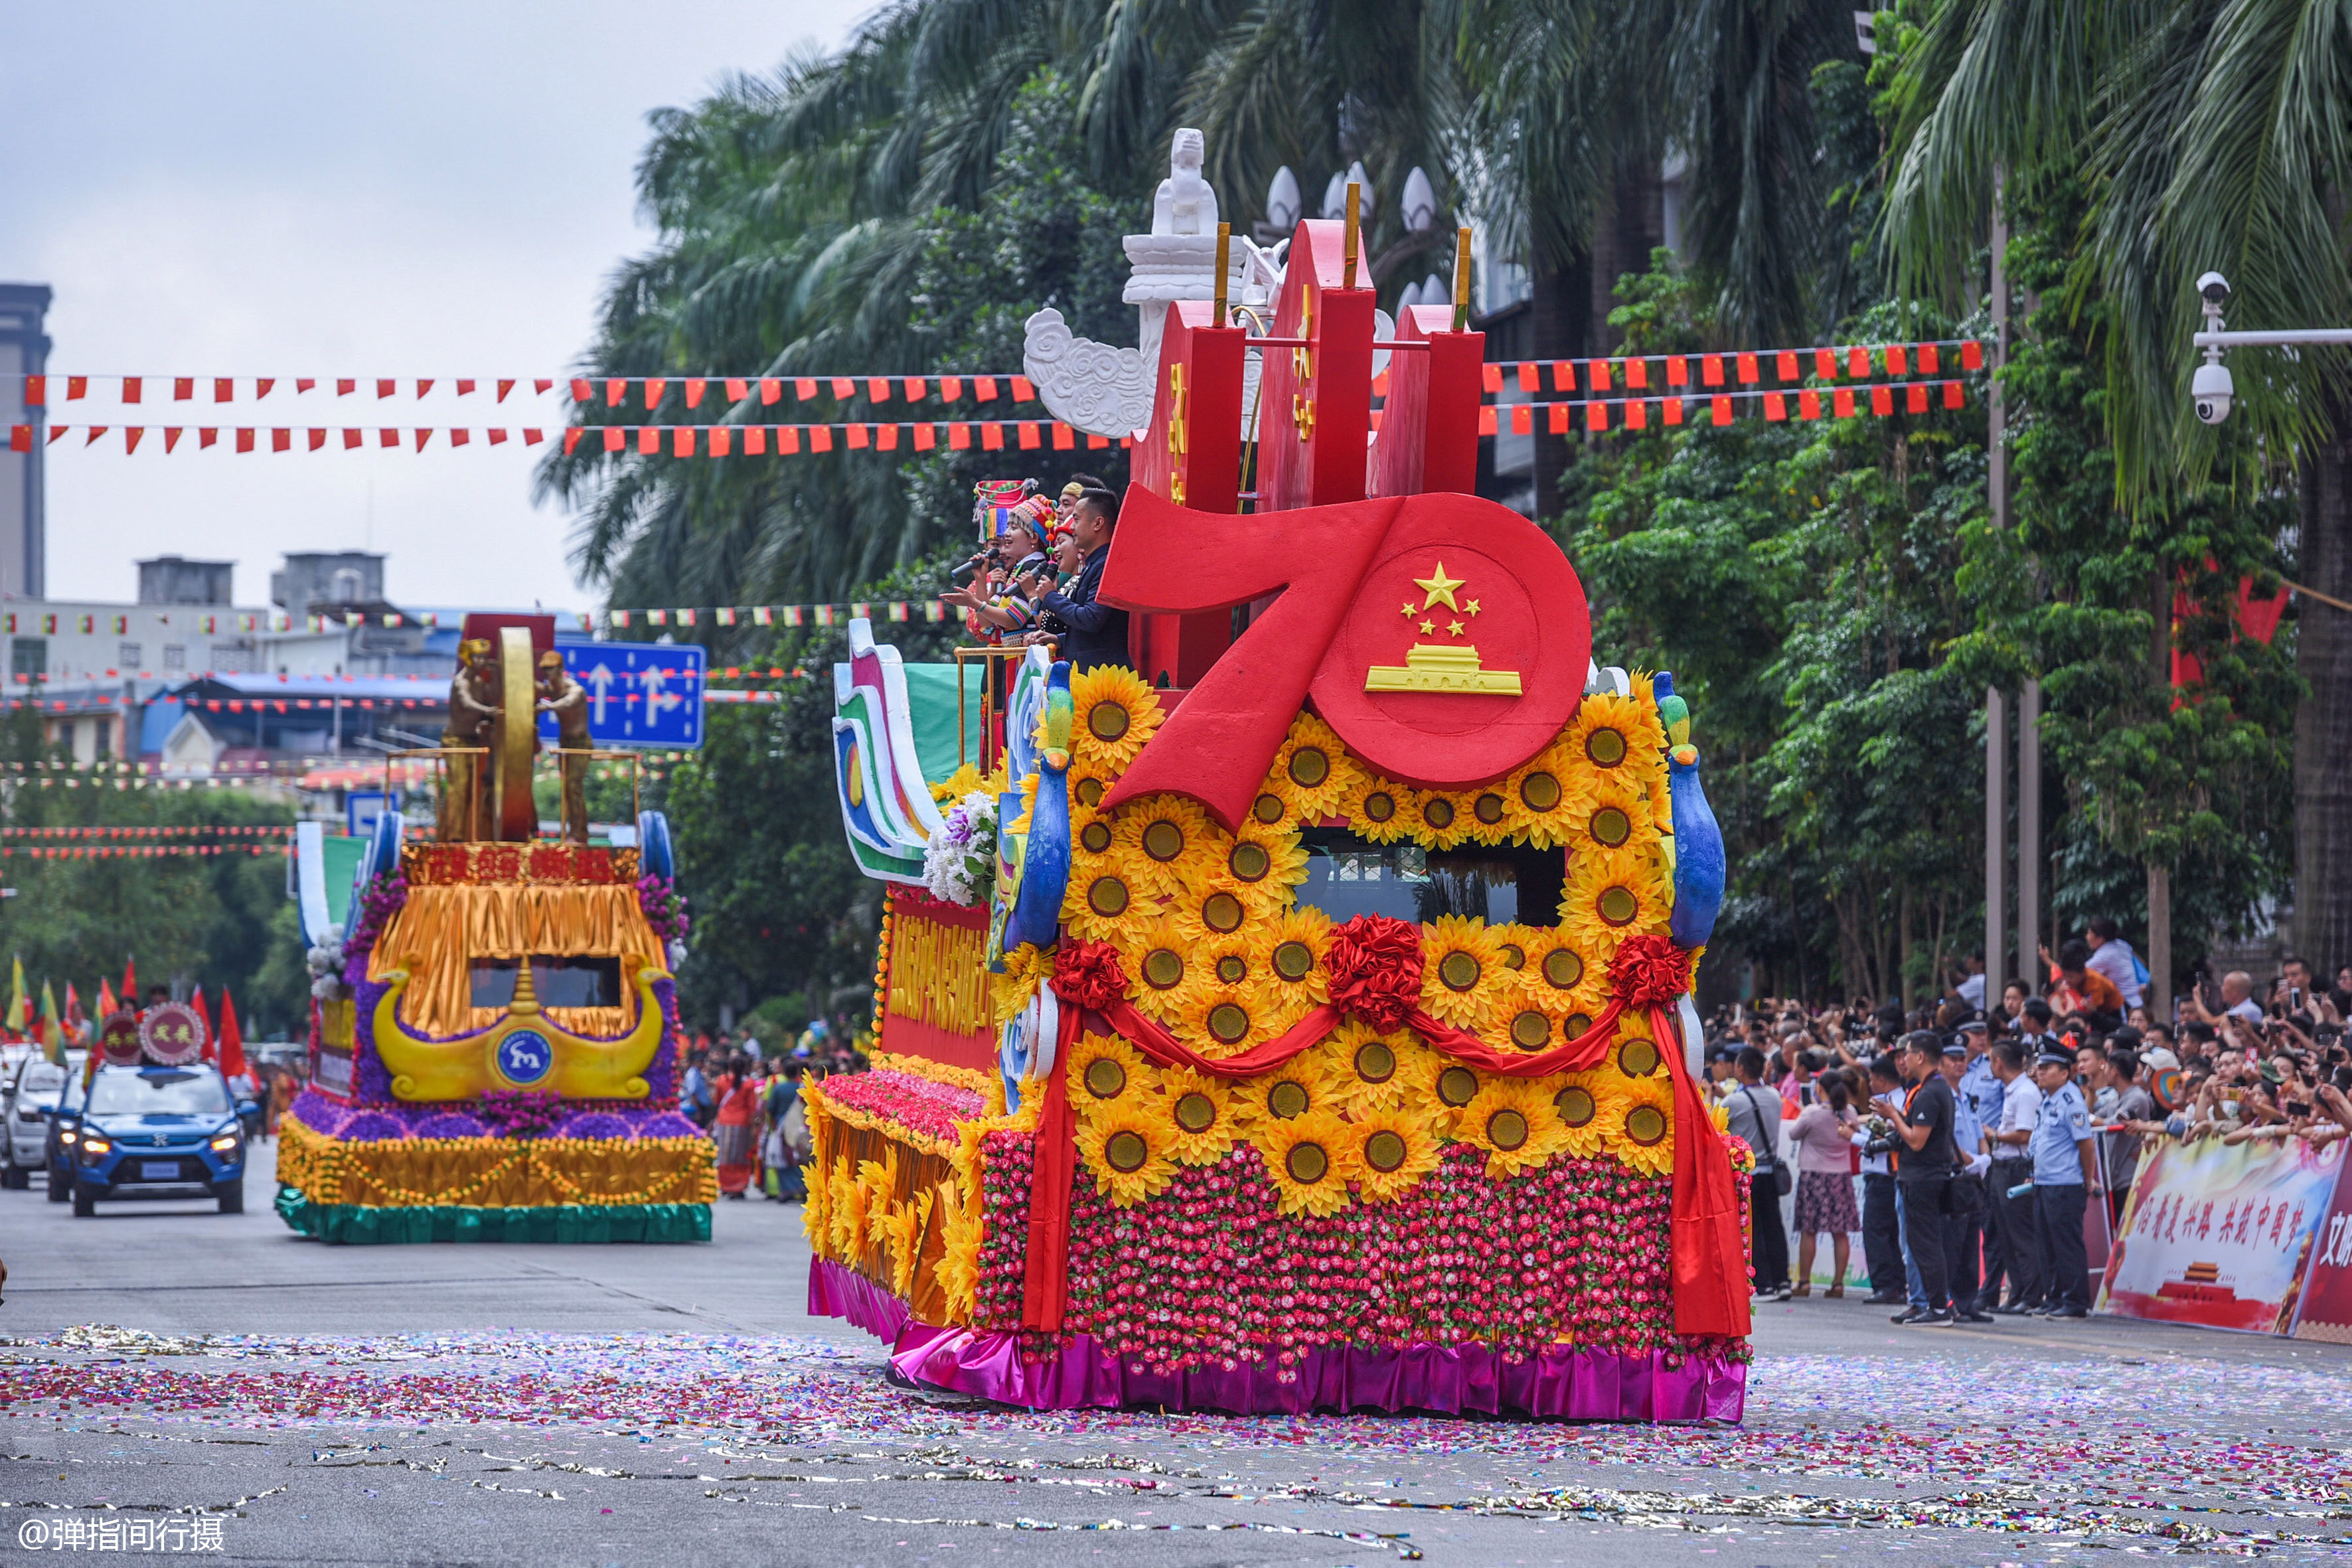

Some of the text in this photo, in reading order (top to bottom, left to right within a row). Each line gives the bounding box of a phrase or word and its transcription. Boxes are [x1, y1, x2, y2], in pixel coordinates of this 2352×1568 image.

[1095, 481, 1591, 835] 70
[2137, 1192, 2306, 1253] 沿着复兴路 共筑中国梦
